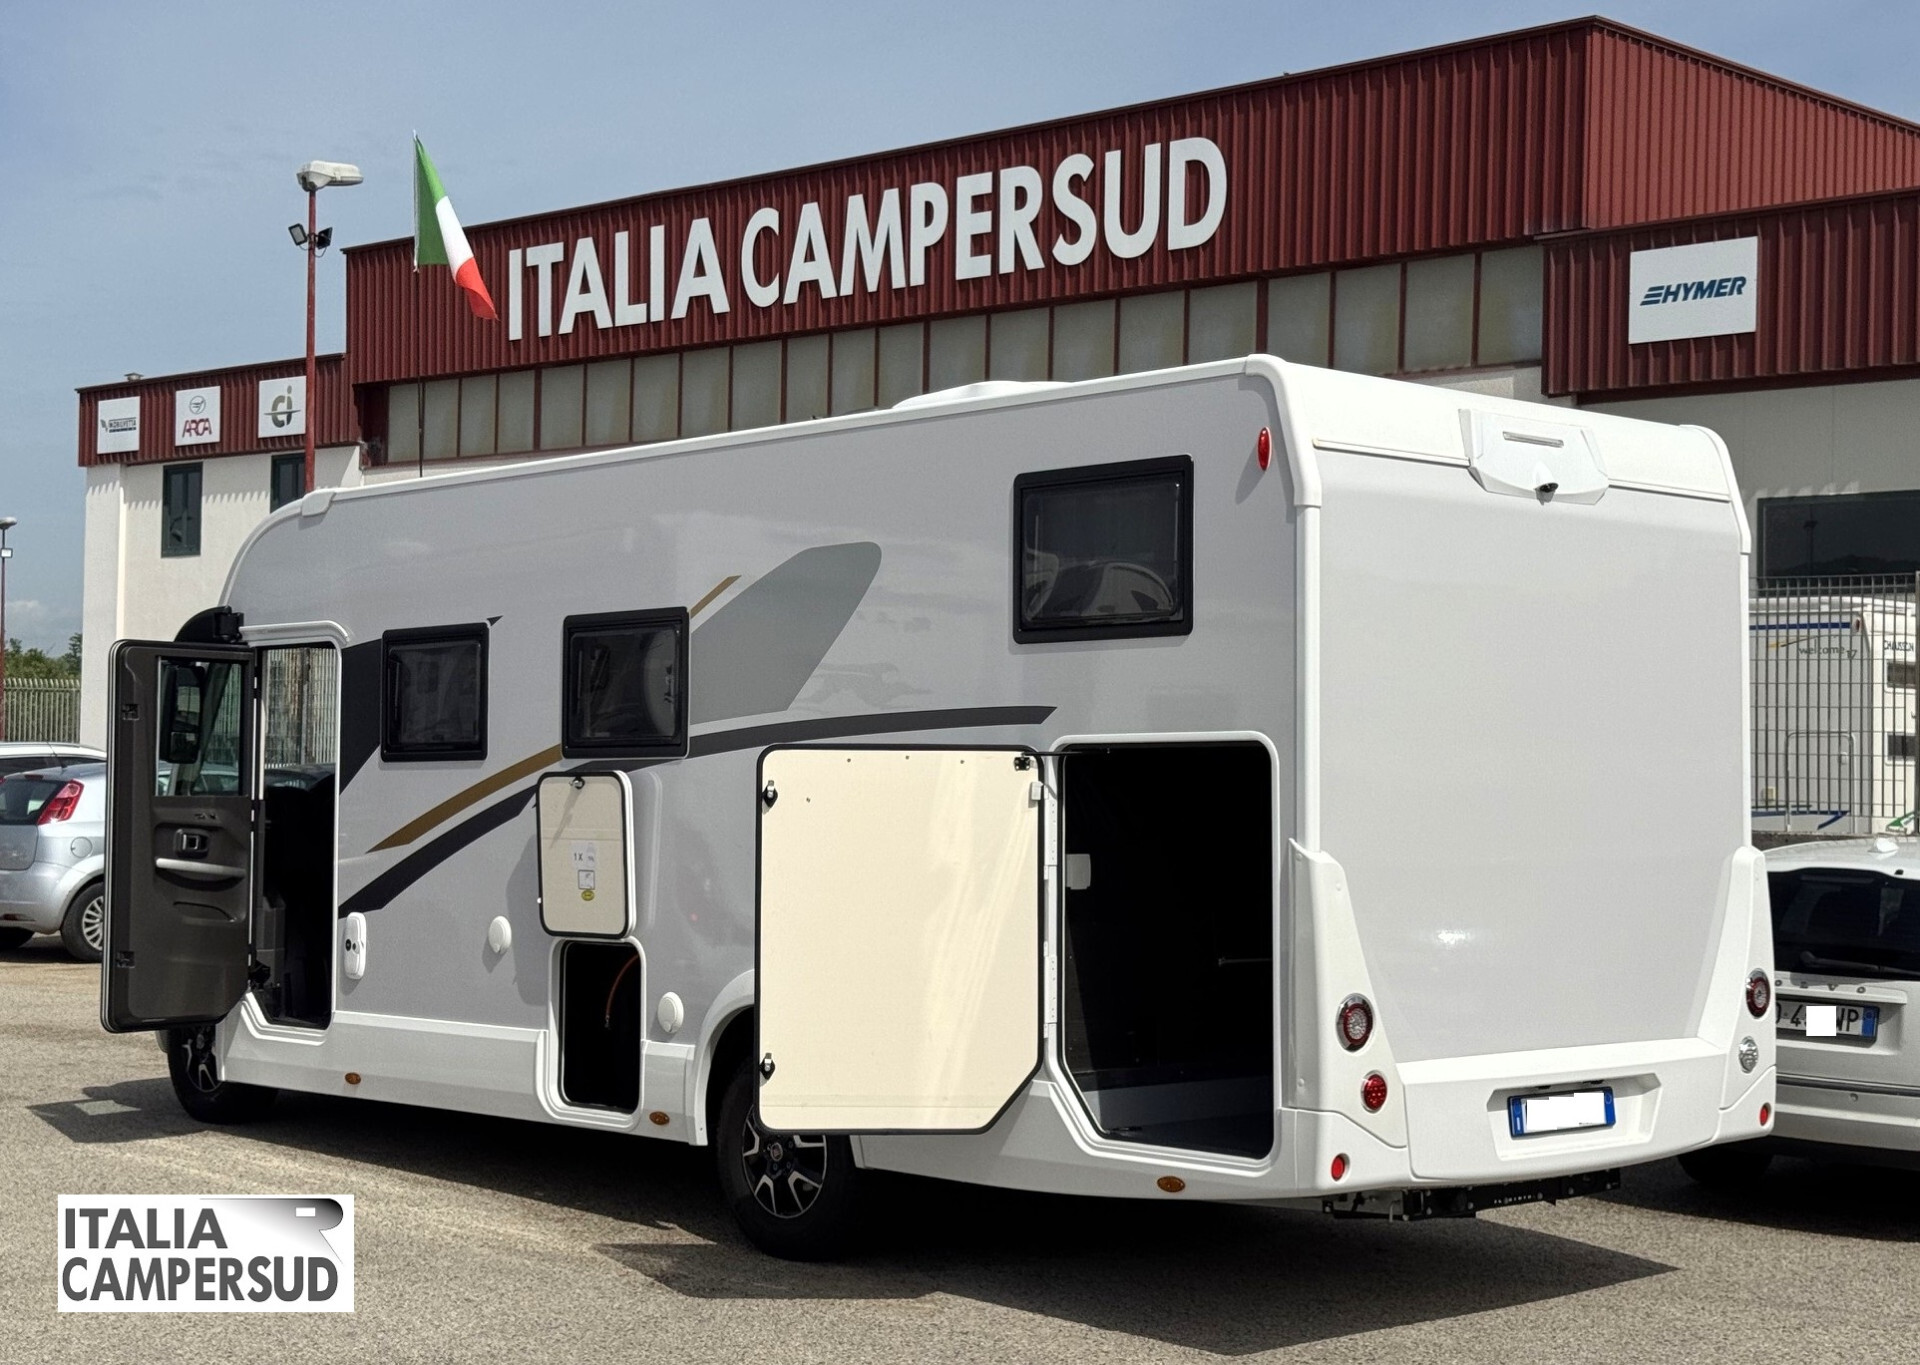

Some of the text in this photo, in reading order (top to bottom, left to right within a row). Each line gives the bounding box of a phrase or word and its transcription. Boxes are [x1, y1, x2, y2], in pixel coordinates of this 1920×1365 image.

[508, 136, 1229, 341] ITALIA CAMPERSUD
[1660, 276, 1747, 304] HYMER
[182, 418, 212, 438] ARCA
